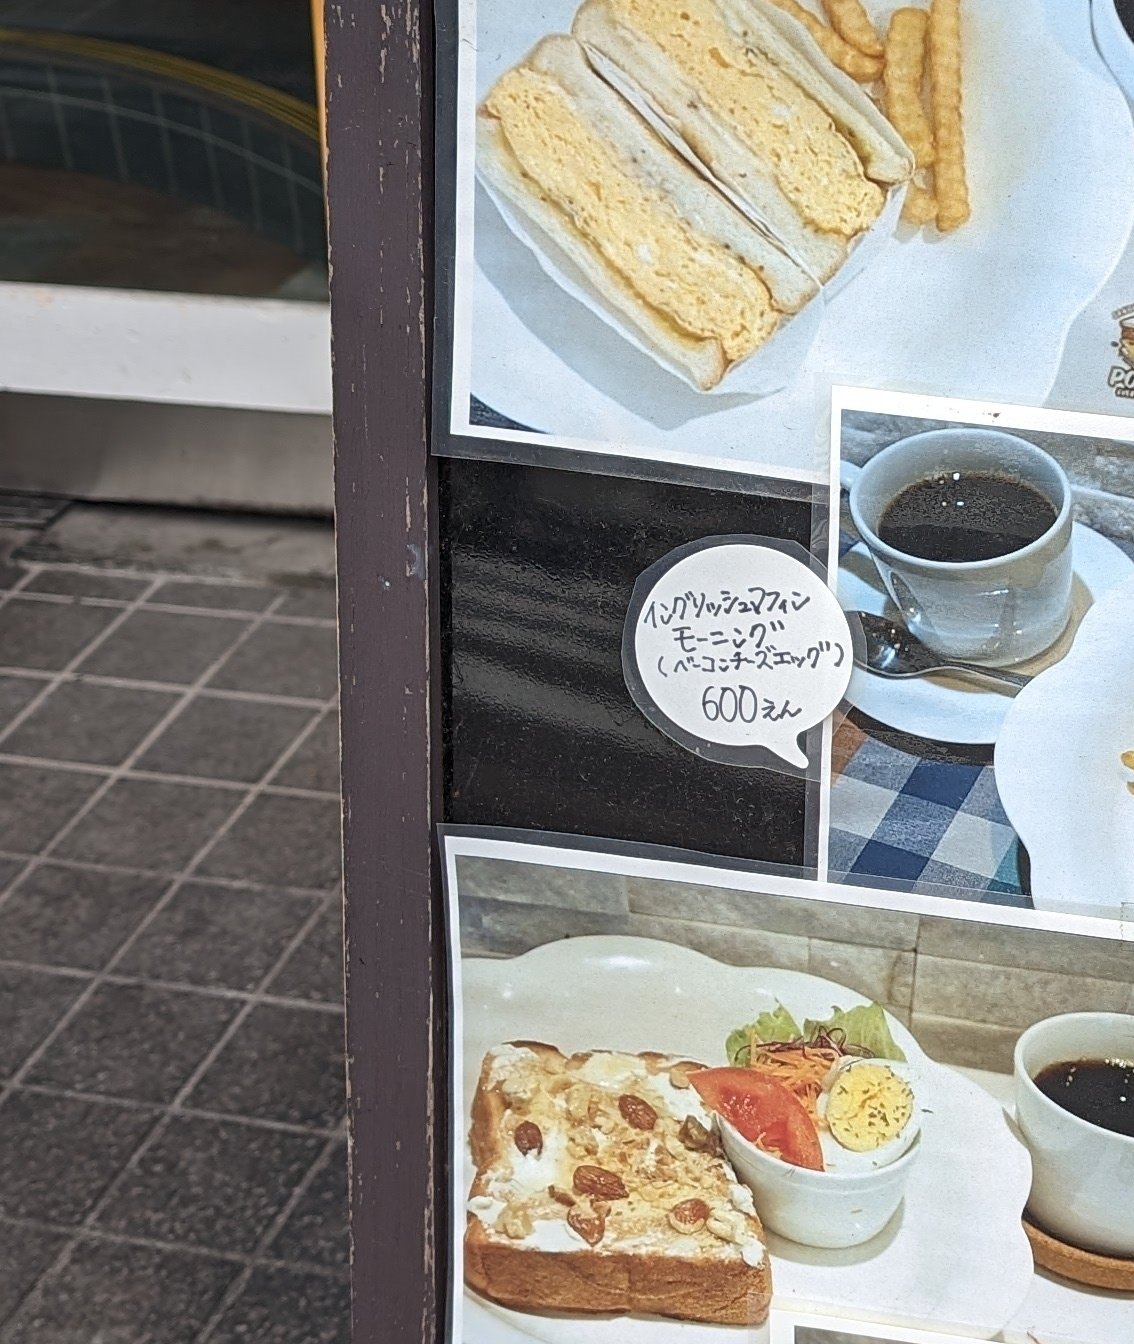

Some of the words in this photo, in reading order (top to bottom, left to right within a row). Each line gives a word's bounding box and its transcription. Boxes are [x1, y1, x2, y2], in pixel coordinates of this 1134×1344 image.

[643, 586, 811, 628] イングリッシュマフィン
[672, 620, 785, 653] モーニング
[702, 685, 802, 723] 600えん
